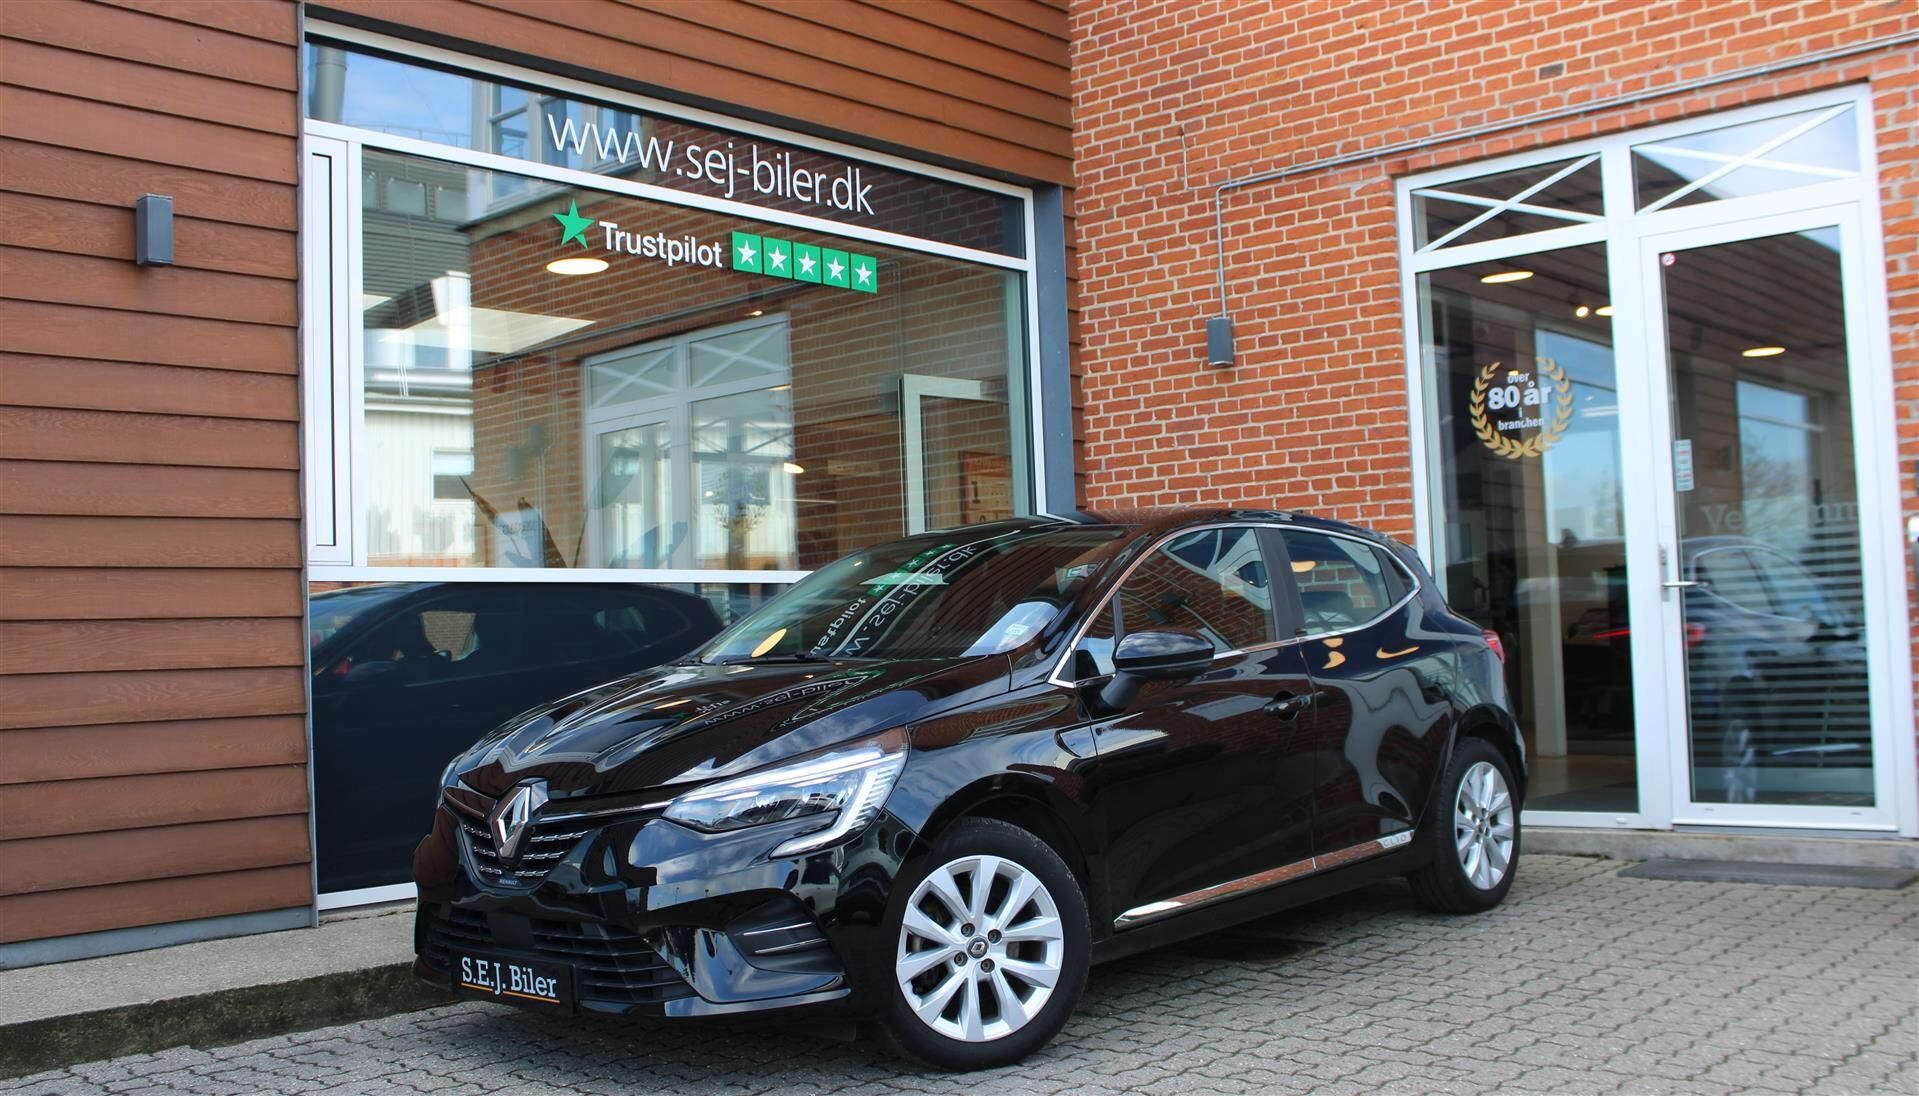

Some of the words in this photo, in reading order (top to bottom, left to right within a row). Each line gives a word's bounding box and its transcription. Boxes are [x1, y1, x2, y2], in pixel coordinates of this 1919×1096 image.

[548, 113, 874, 215] www.sej-biler.dk
[599, 220, 723, 268] Trustpilot
[1507, 372, 1530, 383] over
[1488, 385, 1520, 410] 80
[1523, 381, 1551, 406] år
[1498, 417, 1545, 431] branchen
[462, 956, 506, 995] S.E.J.
[509, 965, 557, 998] Biler
